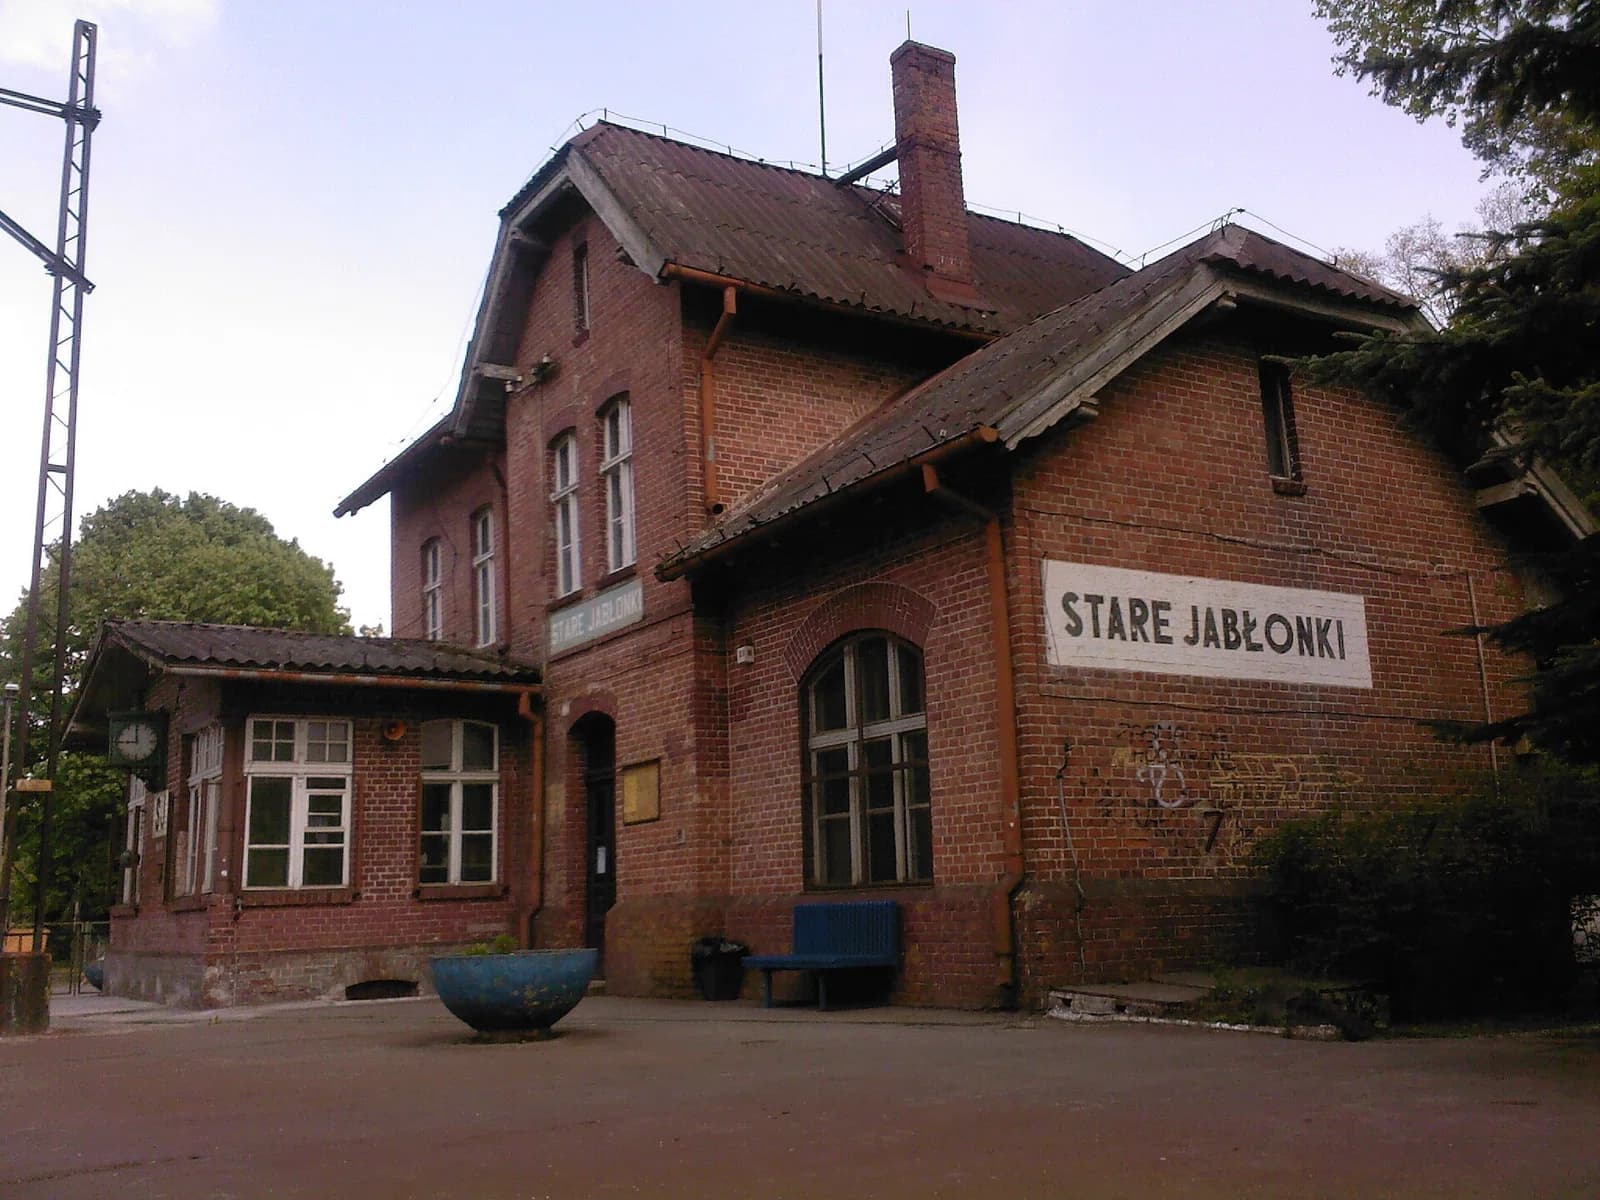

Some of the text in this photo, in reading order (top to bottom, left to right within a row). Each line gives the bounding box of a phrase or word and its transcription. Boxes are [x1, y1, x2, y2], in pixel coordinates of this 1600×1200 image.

[552, 612, 584, 645] STARE
[1061, 591, 1346, 660] STARE JABŁONKI
